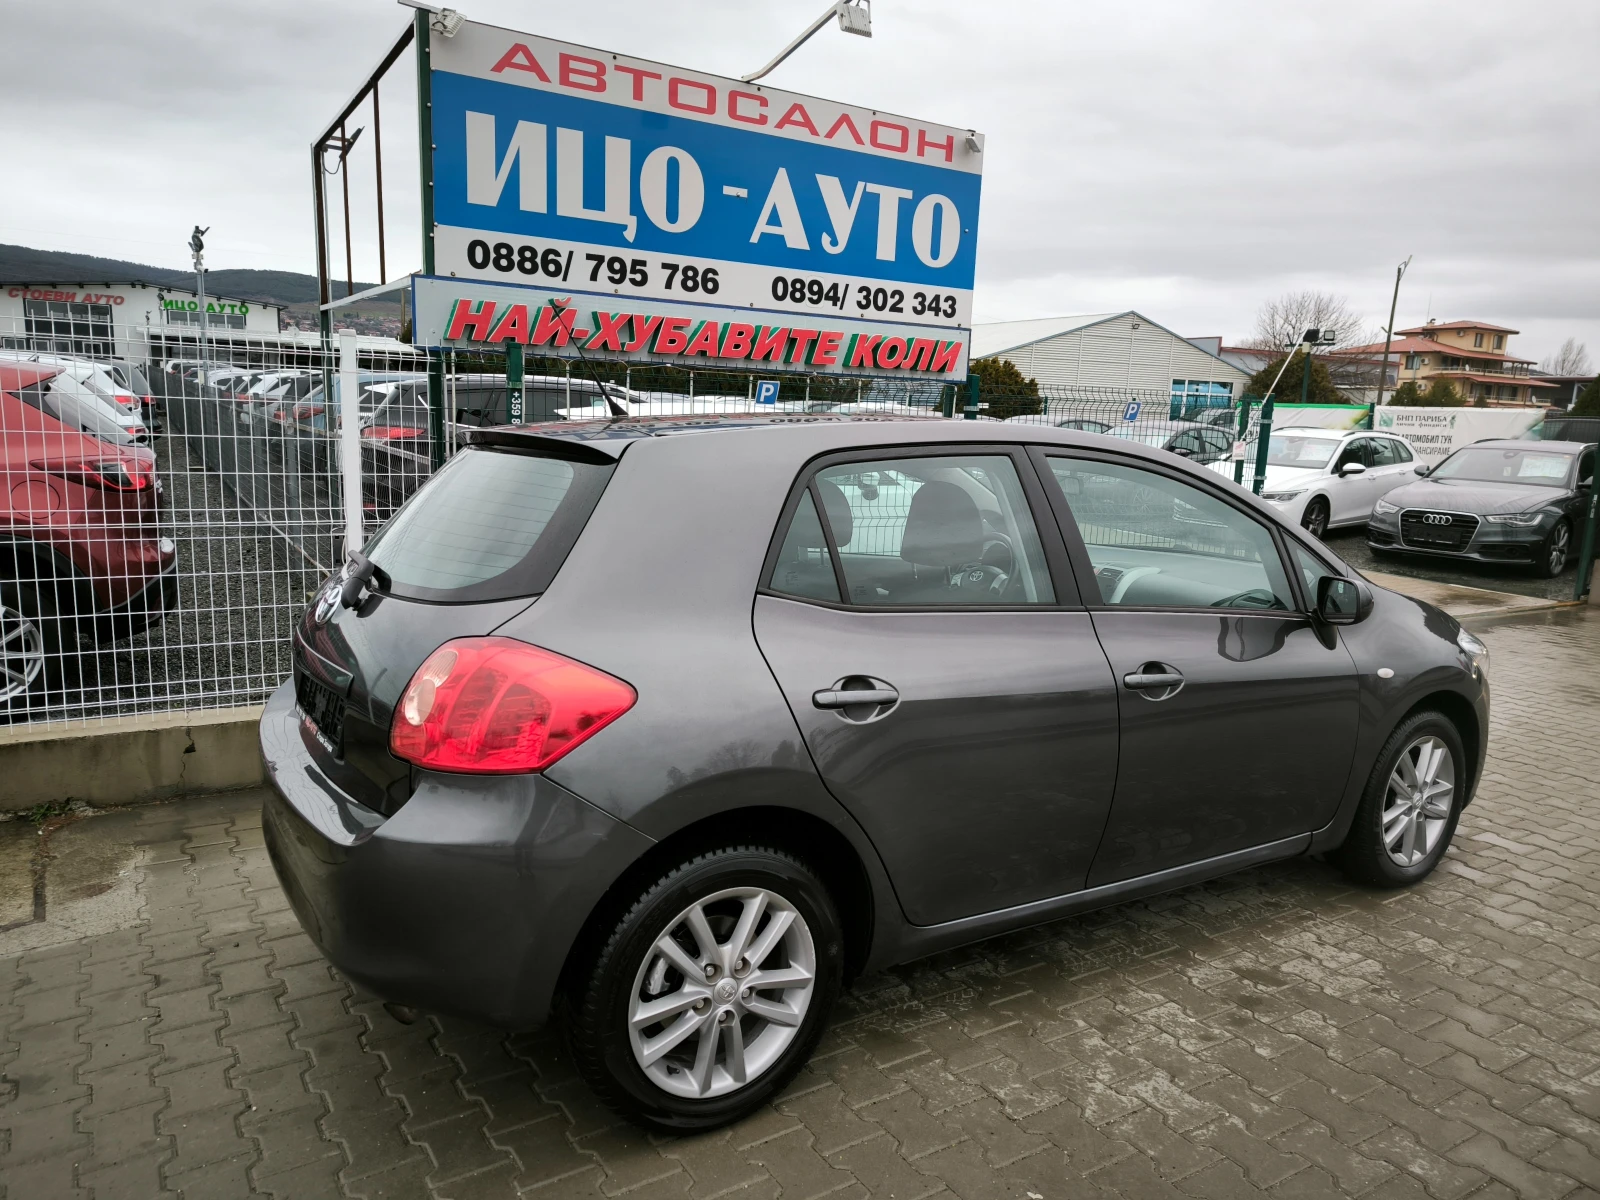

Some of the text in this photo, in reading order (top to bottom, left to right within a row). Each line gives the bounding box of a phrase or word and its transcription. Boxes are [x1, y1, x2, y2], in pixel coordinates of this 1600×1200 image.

[490, 43, 955, 163] АВТОСАЛОН
[467, 240, 720, 295] 0886/ 795 786
[8, 287, 125, 306] СТОЕВИ АУТО
[163, 299, 249, 315] ИЦО АУТО
[771, 276, 957, 318] 0894/ 302 343
[444, 296, 962, 373] НАЙ-ХУБАВИТЕ КОЛИ
[511, 391, 522, 416] +359
[1396, 414, 1414, 422] БНП
[1440, 435, 1453, 444] ТУК
